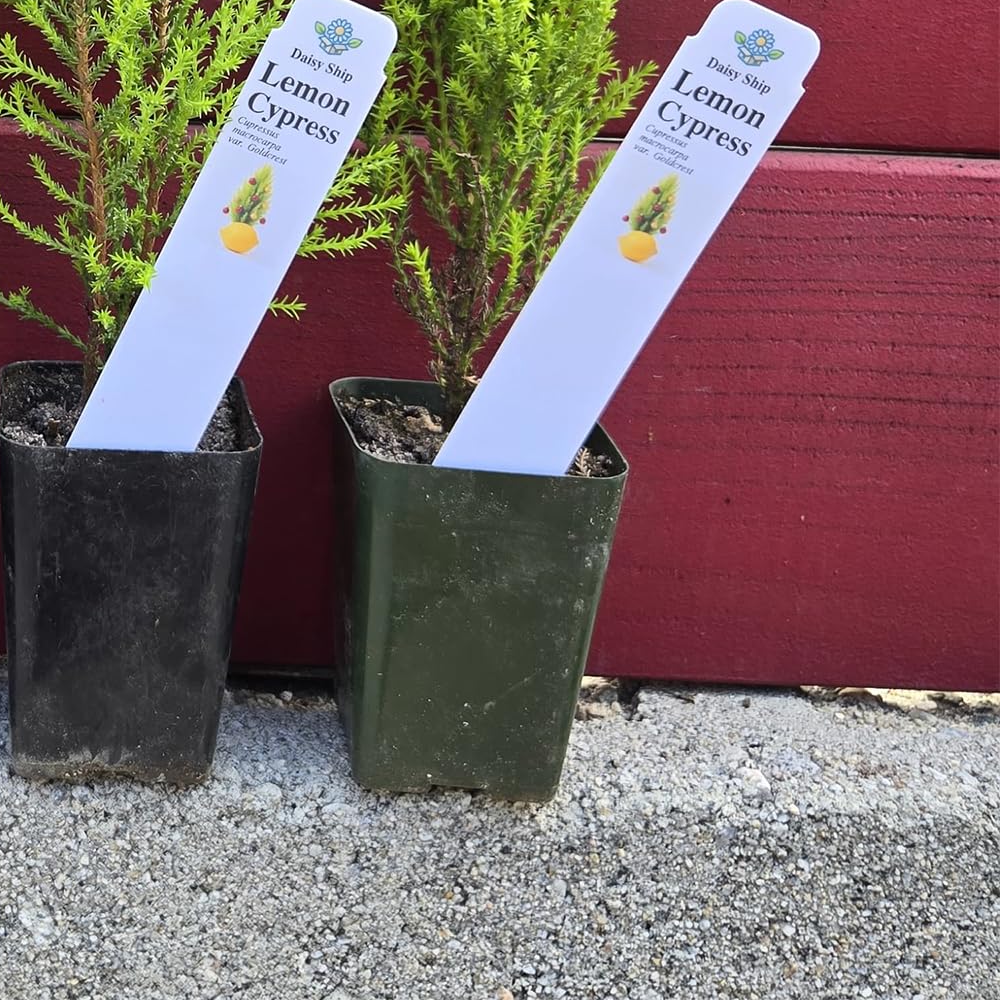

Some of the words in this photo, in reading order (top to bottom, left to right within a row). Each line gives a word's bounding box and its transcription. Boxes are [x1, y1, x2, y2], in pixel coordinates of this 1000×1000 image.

[290, 48, 324, 71] Daisy
[325, 62, 353, 83] Ship
[706, 57, 741, 81] Daisy
[742, 73, 771, 95] Ship
[258, 60, 350, 117] Lemon
[671, 68, 765, 129] Lemon
[238, 116, 280, 138] Cupressus
[248, 92, 340, 144] Cypress
[658, 100, 752, 157] Cypress
[228, 137, 243, 147] var.
[248, 144, 287, 165] Goldcrest
[232, 127, 282, 151] macrocarpa
[639, 135, 689, 161] macrocarpa
[645, 124, 688, 148] Cupressus
[633, 144, 648, 155] var.
[654, 152, 694, 175] Goldcrest
